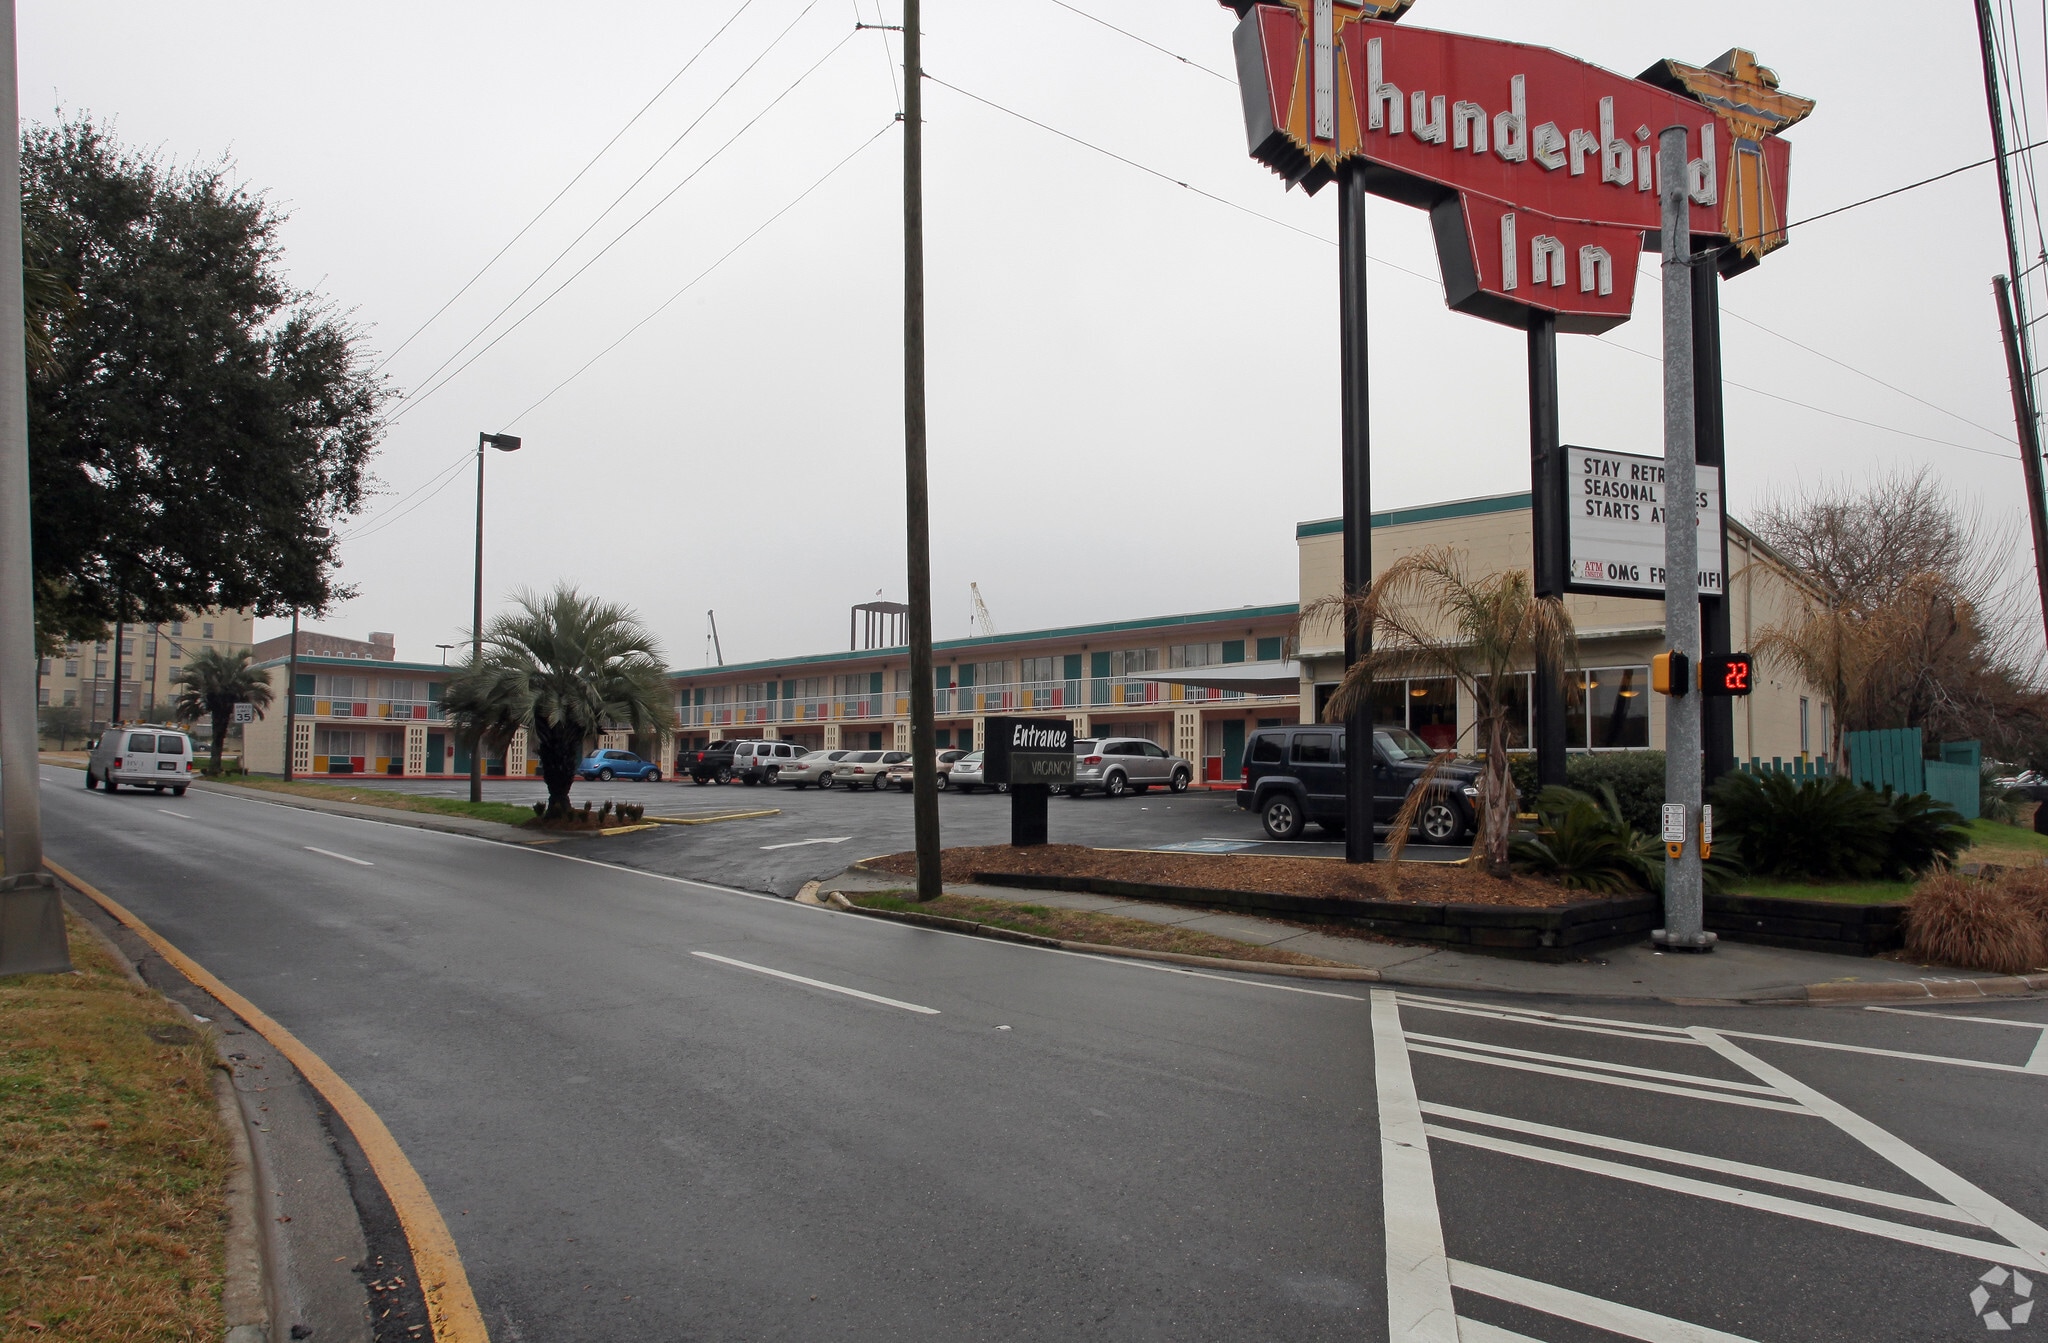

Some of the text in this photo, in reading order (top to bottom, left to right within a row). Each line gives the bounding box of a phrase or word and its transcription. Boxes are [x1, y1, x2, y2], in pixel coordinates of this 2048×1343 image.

[1314, 0, 1717, 206] Thunderbid
[1503, 212, 1613, 296] Inn
[1584, 458, 1665, 483] STAY RETR
[1584, 479, 1657, 502] SEASONAL
[1586, 500, 1665, 523] STARTS AT
[1585, 561, 1603, 571] ATM
[1608, 563, 1639, 581] OMG
[1650, 567, 1665, 583] FR
[1726, 662, 1748, 688] 22
[236, 713, 251, 721] 35
[1013, 724, 1067, 748] Entrance
[1032, 760, 1071, 776] VACANCY
